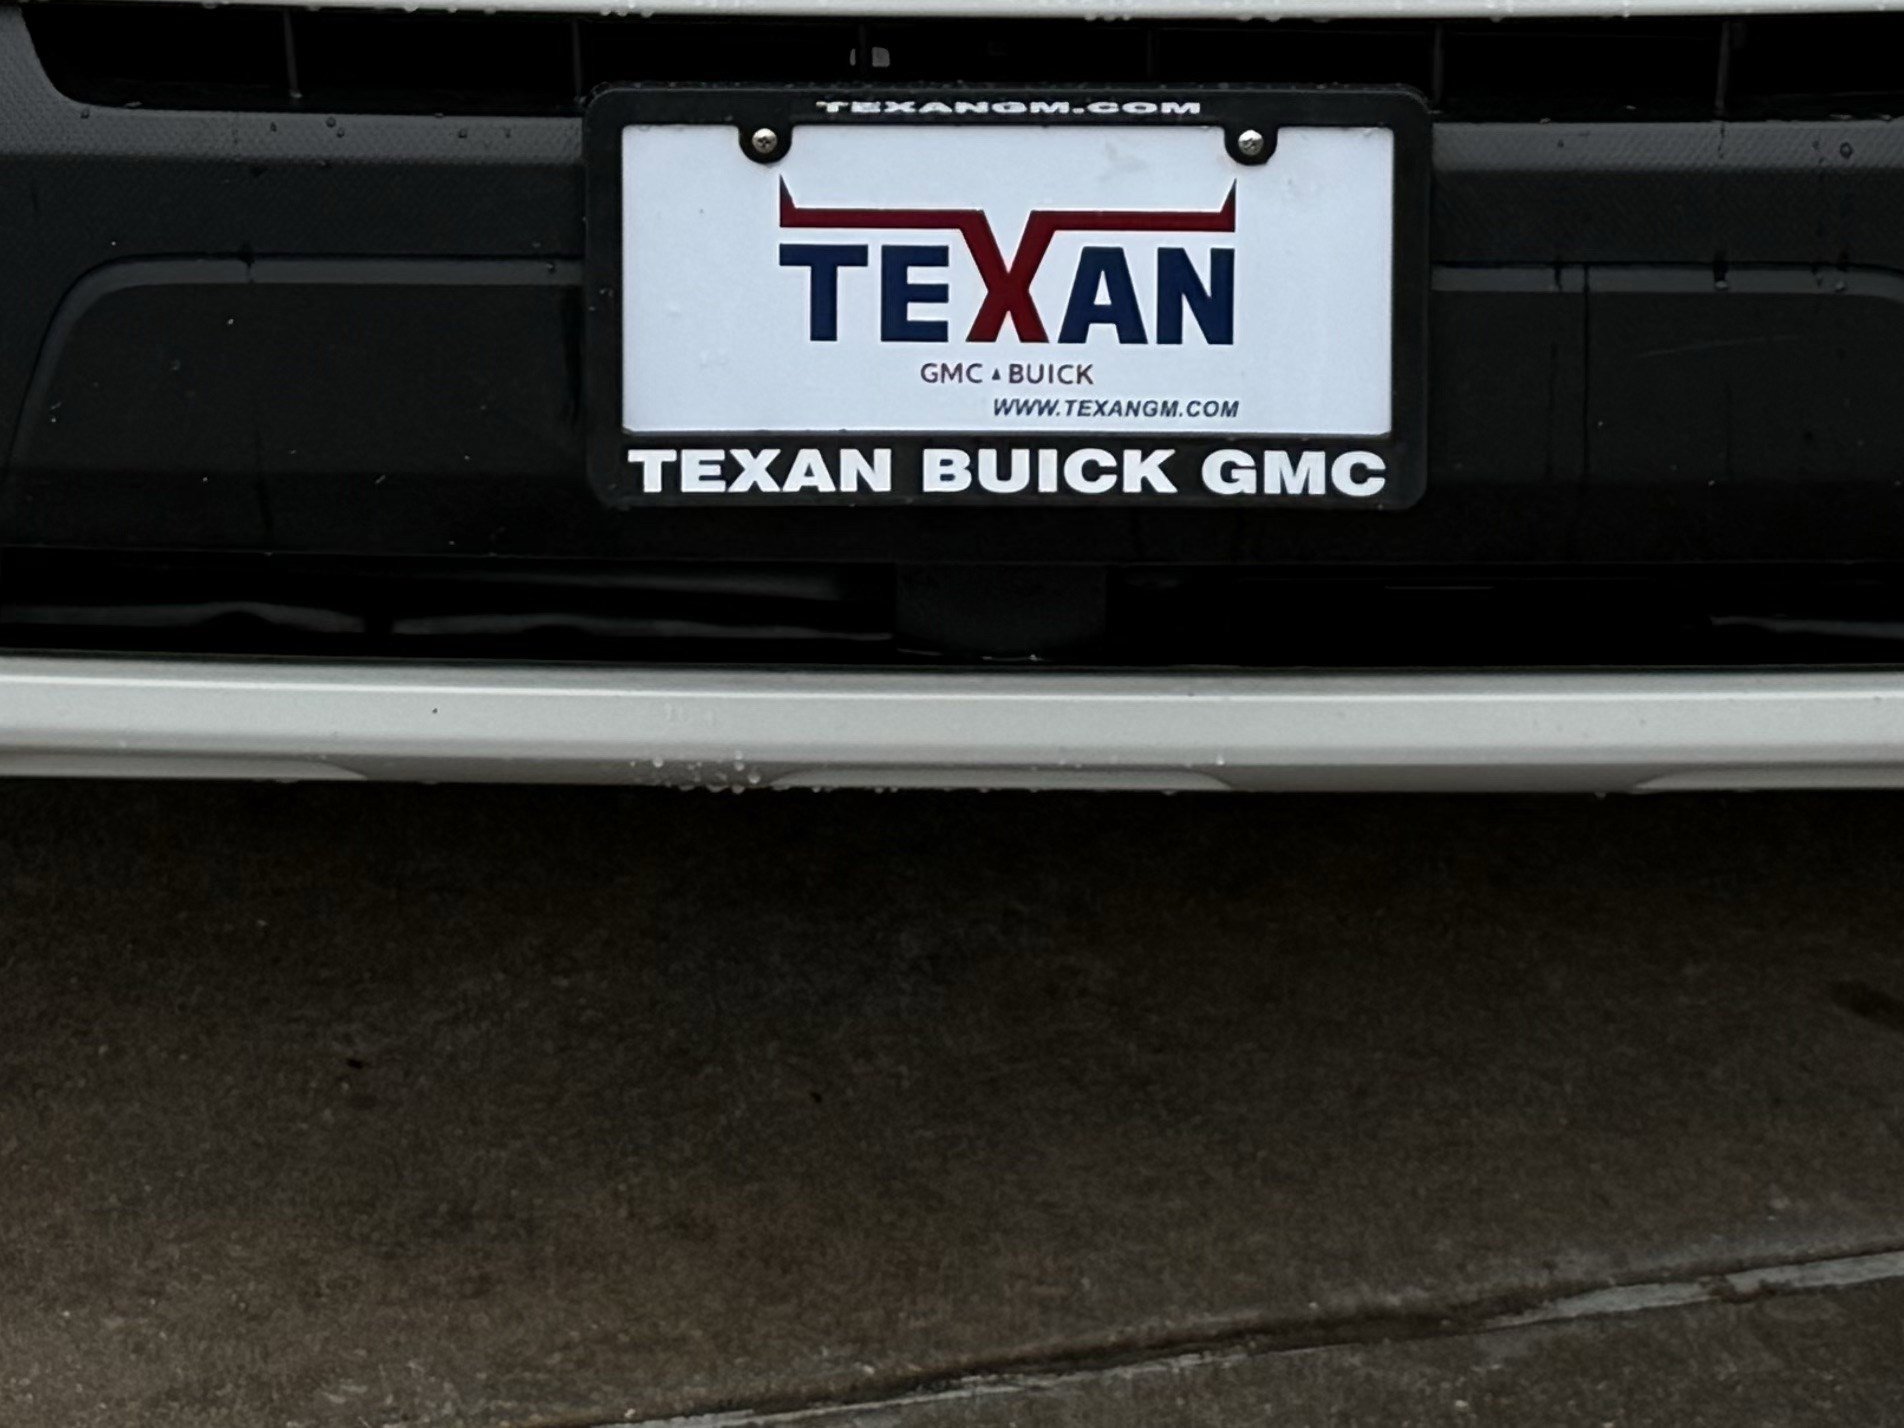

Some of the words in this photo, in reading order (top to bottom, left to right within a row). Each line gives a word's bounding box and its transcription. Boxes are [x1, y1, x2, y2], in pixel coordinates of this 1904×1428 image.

[815, 100, 1202, 116] TEXANGM.COM
[778, 210, 1237, 346] TEXAN
[919, 361, 984, 385] GMC
[1007, 362, 1095, 386] BUICK
[992, 397, 1241, 419] WWW.TEXANGM.COM
[627, 447, 892, 493] TEXAN
[921, 447, 1179, 494] BUICK
[1200, 447, 1387, 497] GMC
